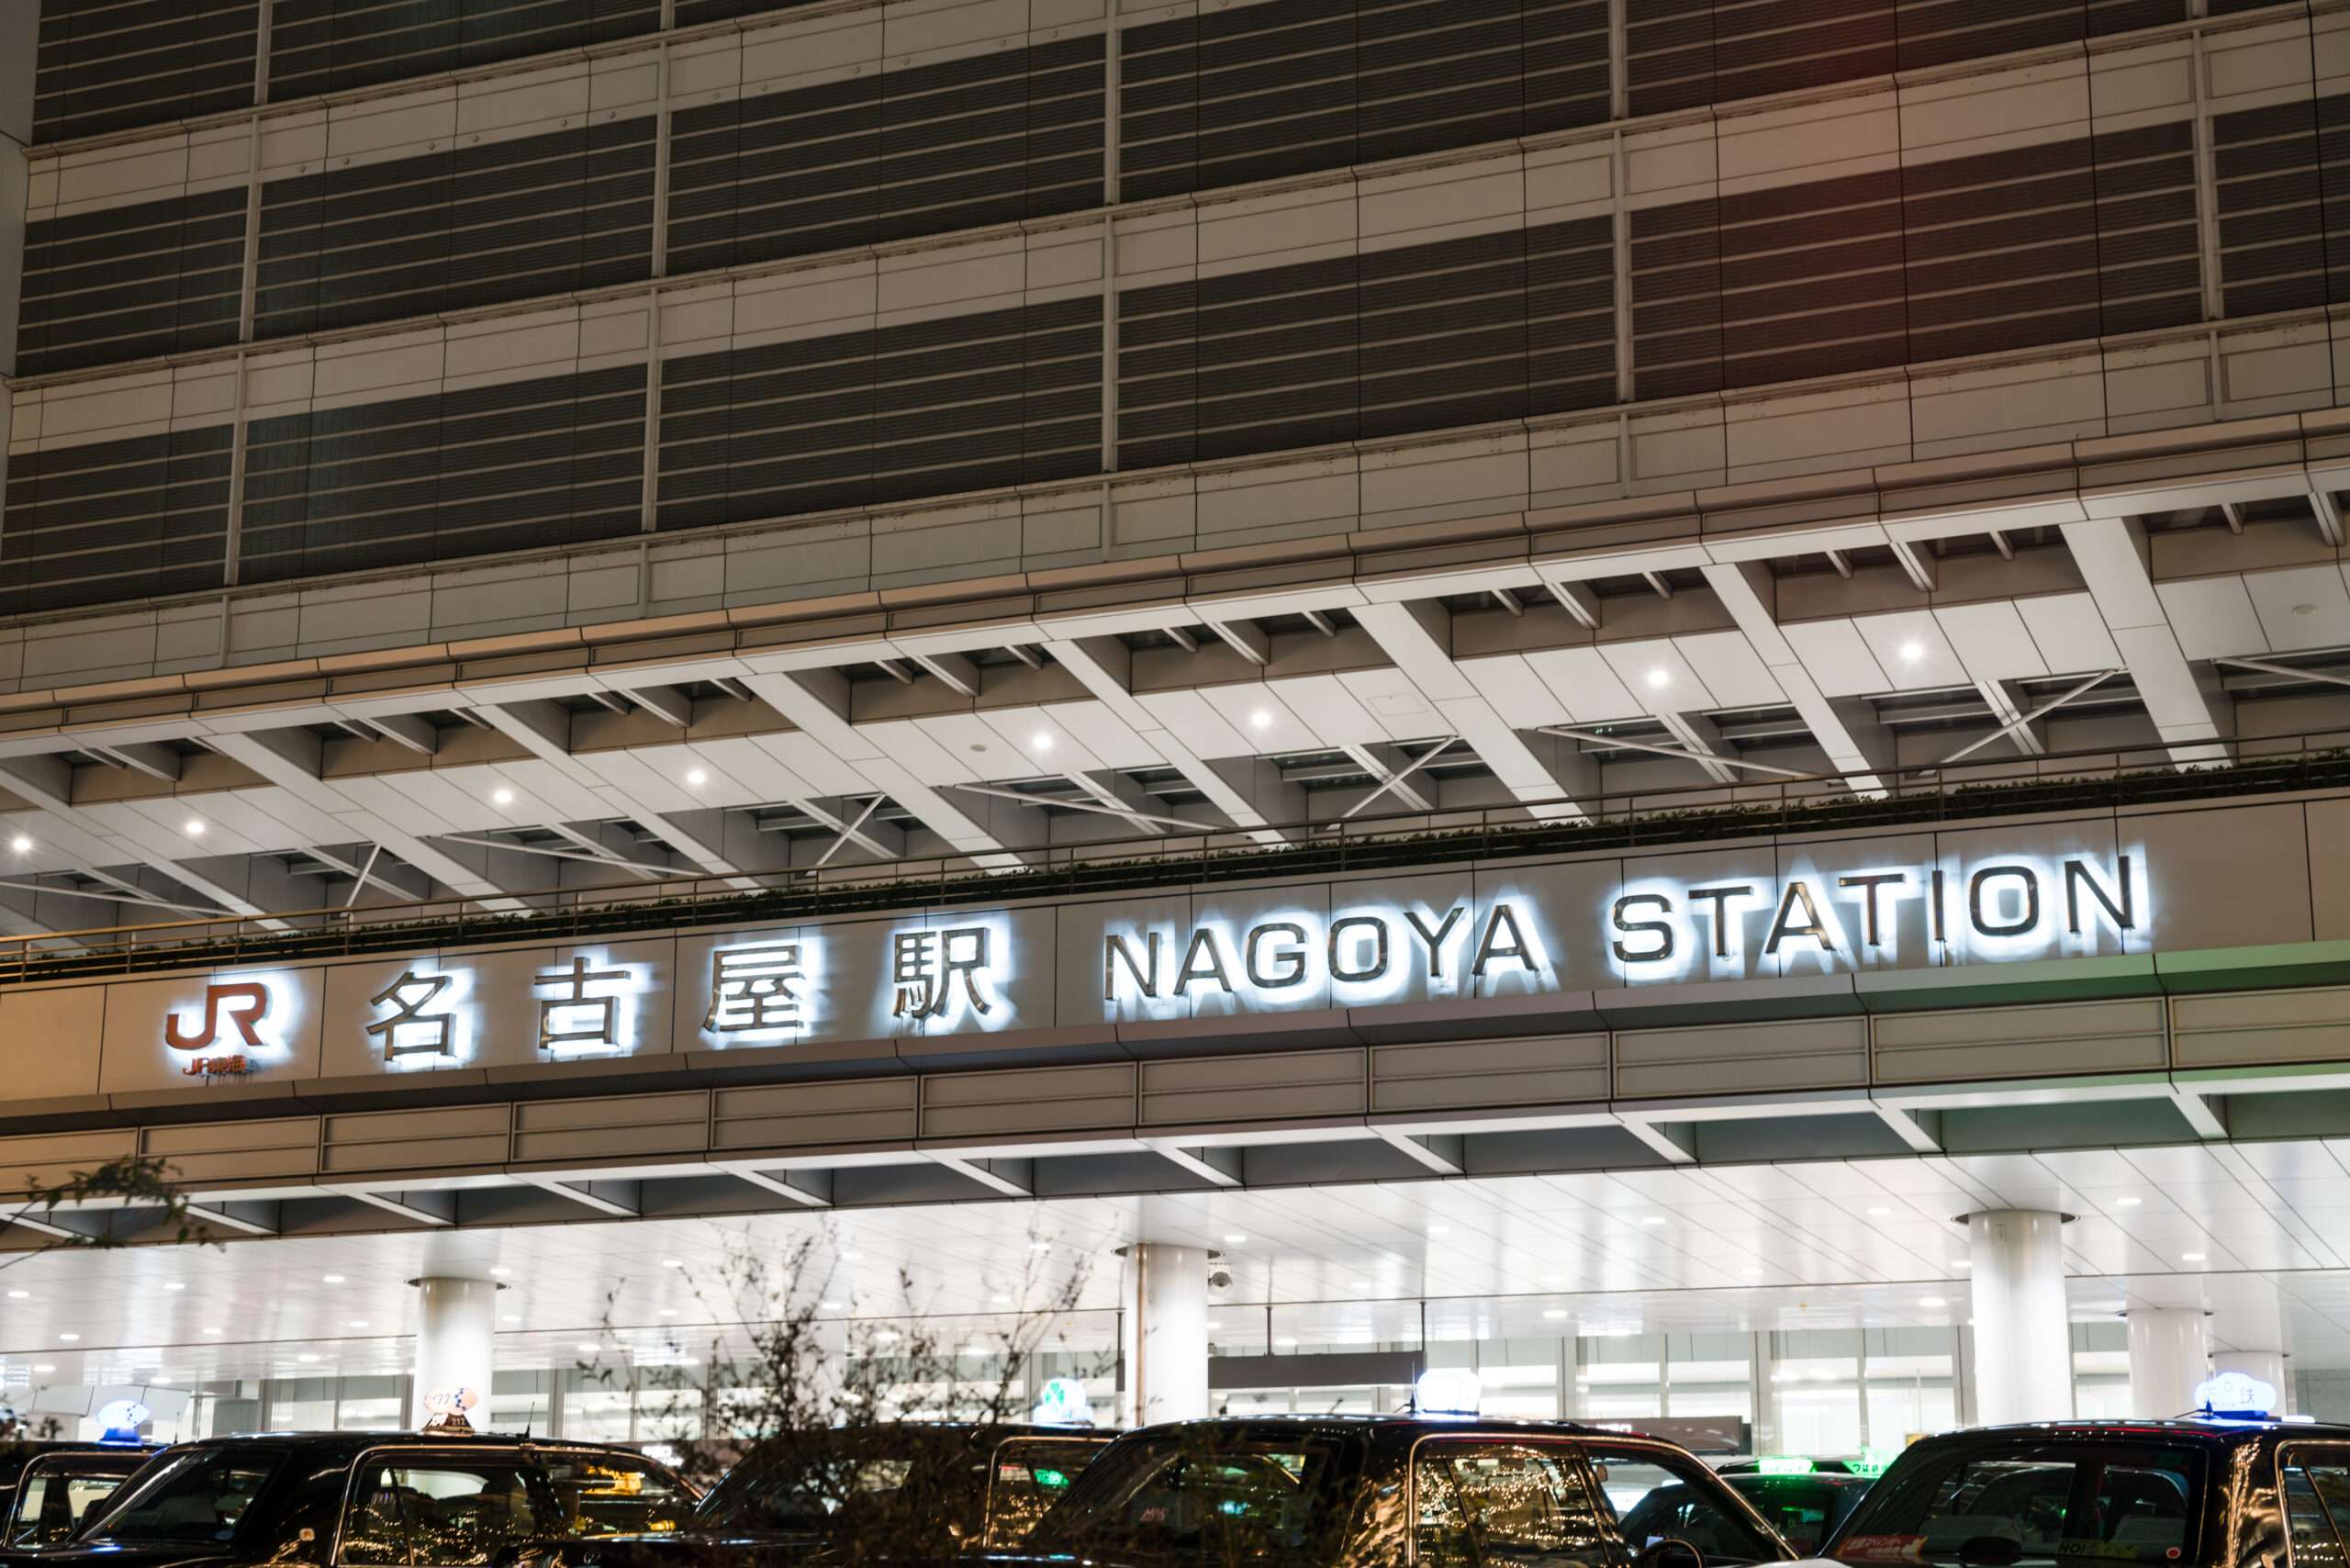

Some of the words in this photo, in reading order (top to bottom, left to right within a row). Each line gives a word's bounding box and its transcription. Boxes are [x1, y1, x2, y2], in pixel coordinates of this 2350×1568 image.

[367, 927, 992, 1061] 名古屋駅
[1104, 904, 1540, 1002] NAGOYA
[1612, 855, 2136, 963] STATION
[166, 982, 267, 1050] JR
